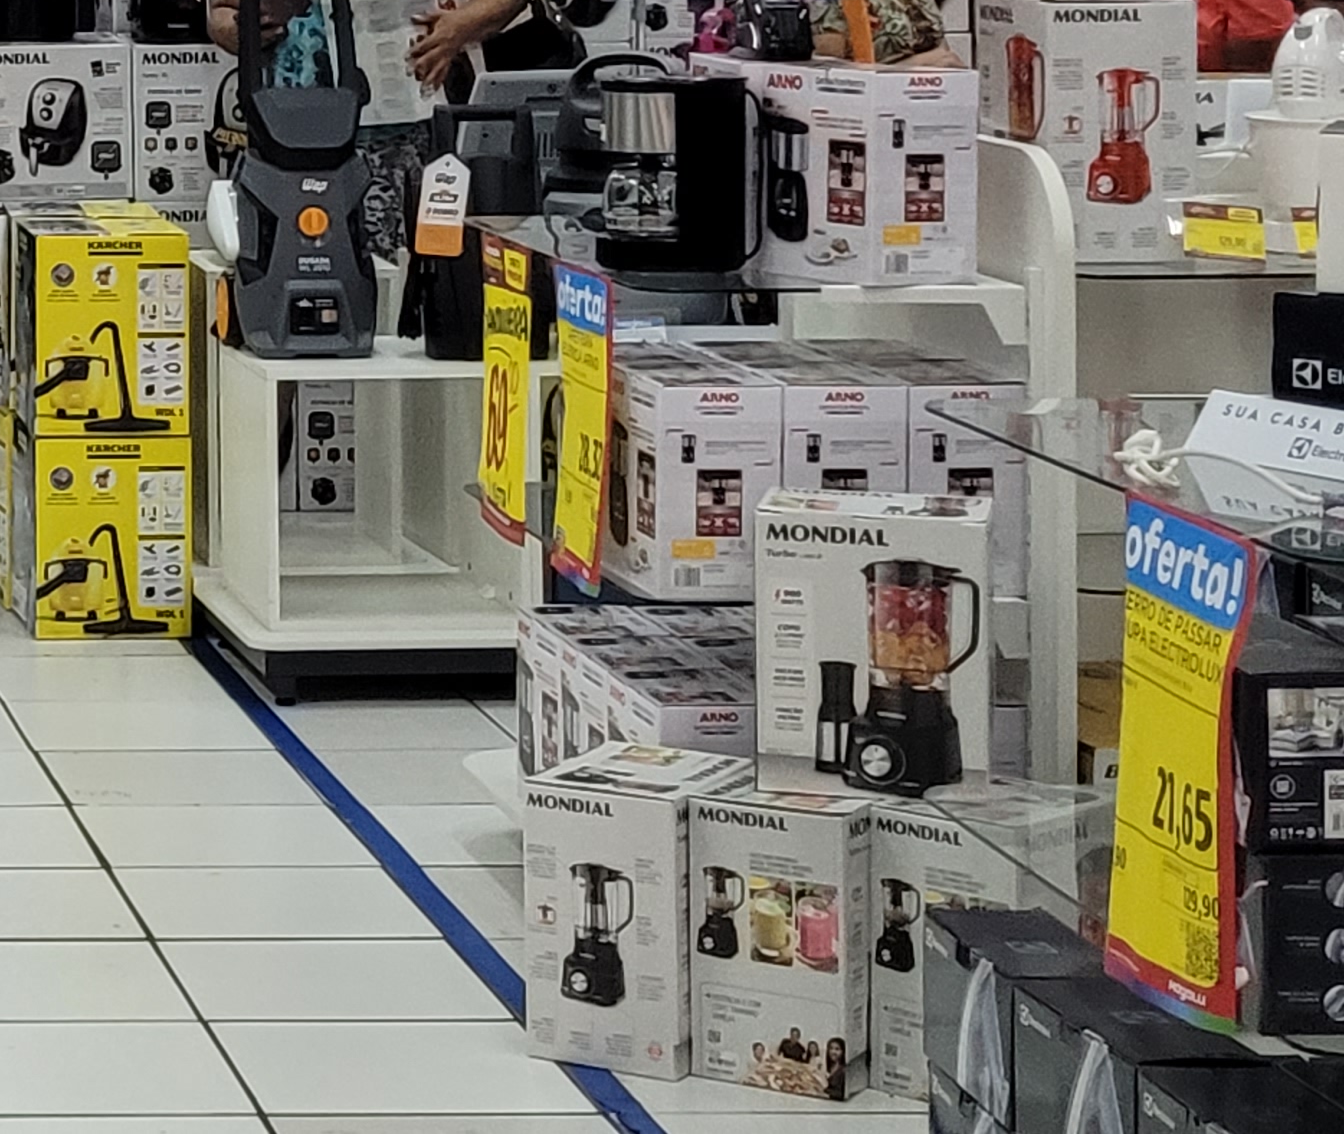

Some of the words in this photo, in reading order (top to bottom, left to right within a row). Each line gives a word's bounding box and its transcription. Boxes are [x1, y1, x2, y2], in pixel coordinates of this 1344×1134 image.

[1052, 9, 1142, 23] MONDIAL
[141, 51, 220, 65] MONDIAL
[767, 73, 803, 90] ARNO
[907, 76, 943, 87] ARNO
[699, 392, 740, 404] ARNO
[824, 391, 865, 403] ARNO
[1222, 403, 1259, 422] SUA
[1270, 412, 1322, 433] CASA
[766, 522, 890, 547] MONDIAL
[1125, 517, 1244, 616] oferta!
[1174, 614, 1223, 655] PASSAR
[699, 711, 740, 723] ARNO
[526, 792, 615, 818] MONDIAL
[1151, 766, 1213, 852] 21,65
[697, 806, 789, 832] MONDIAL
[876, 815, 964, 847] MONDIAL
